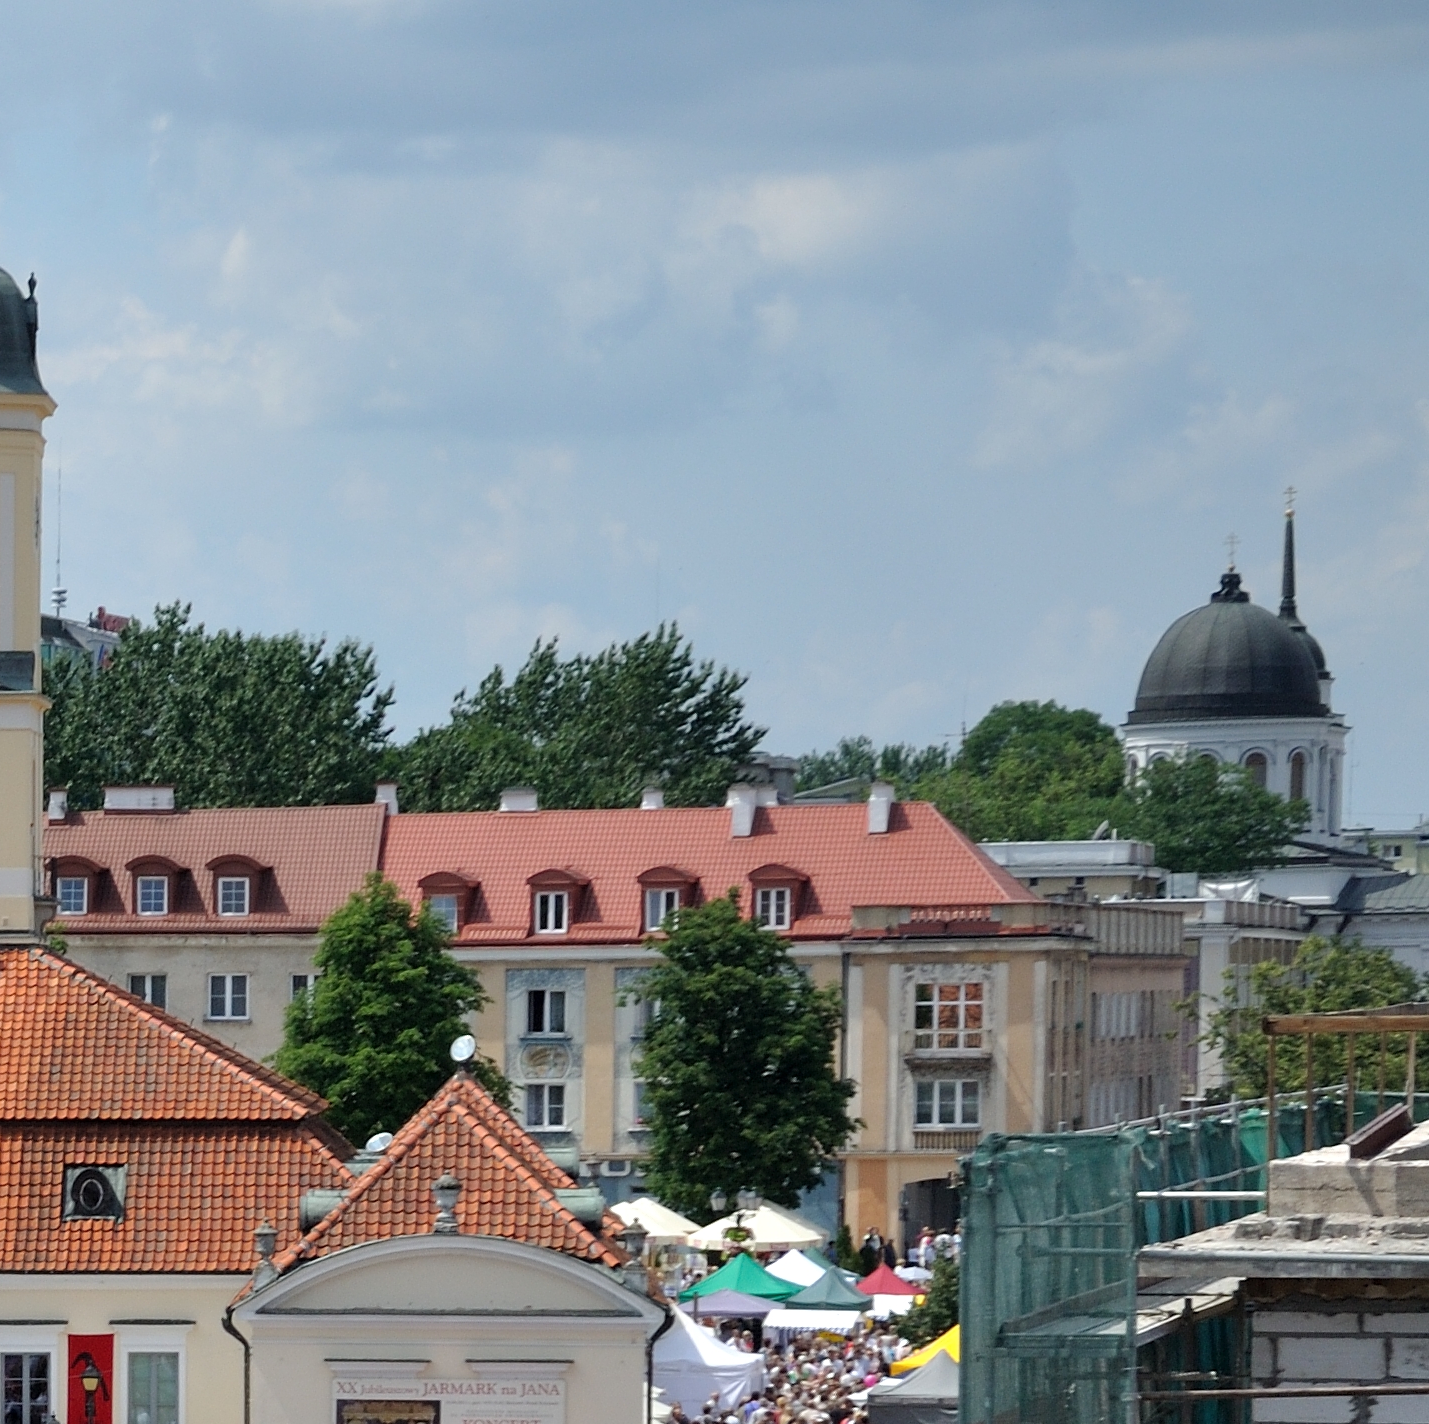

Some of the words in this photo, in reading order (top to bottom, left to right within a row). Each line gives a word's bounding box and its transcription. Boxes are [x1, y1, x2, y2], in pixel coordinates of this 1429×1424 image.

[336, 1381, 358, 1394] XX
[422, 1382, 497, 1397] JARMARK
[501, 1387, 517, 1395] na
[519, 1382, 560, 1398] JANA
